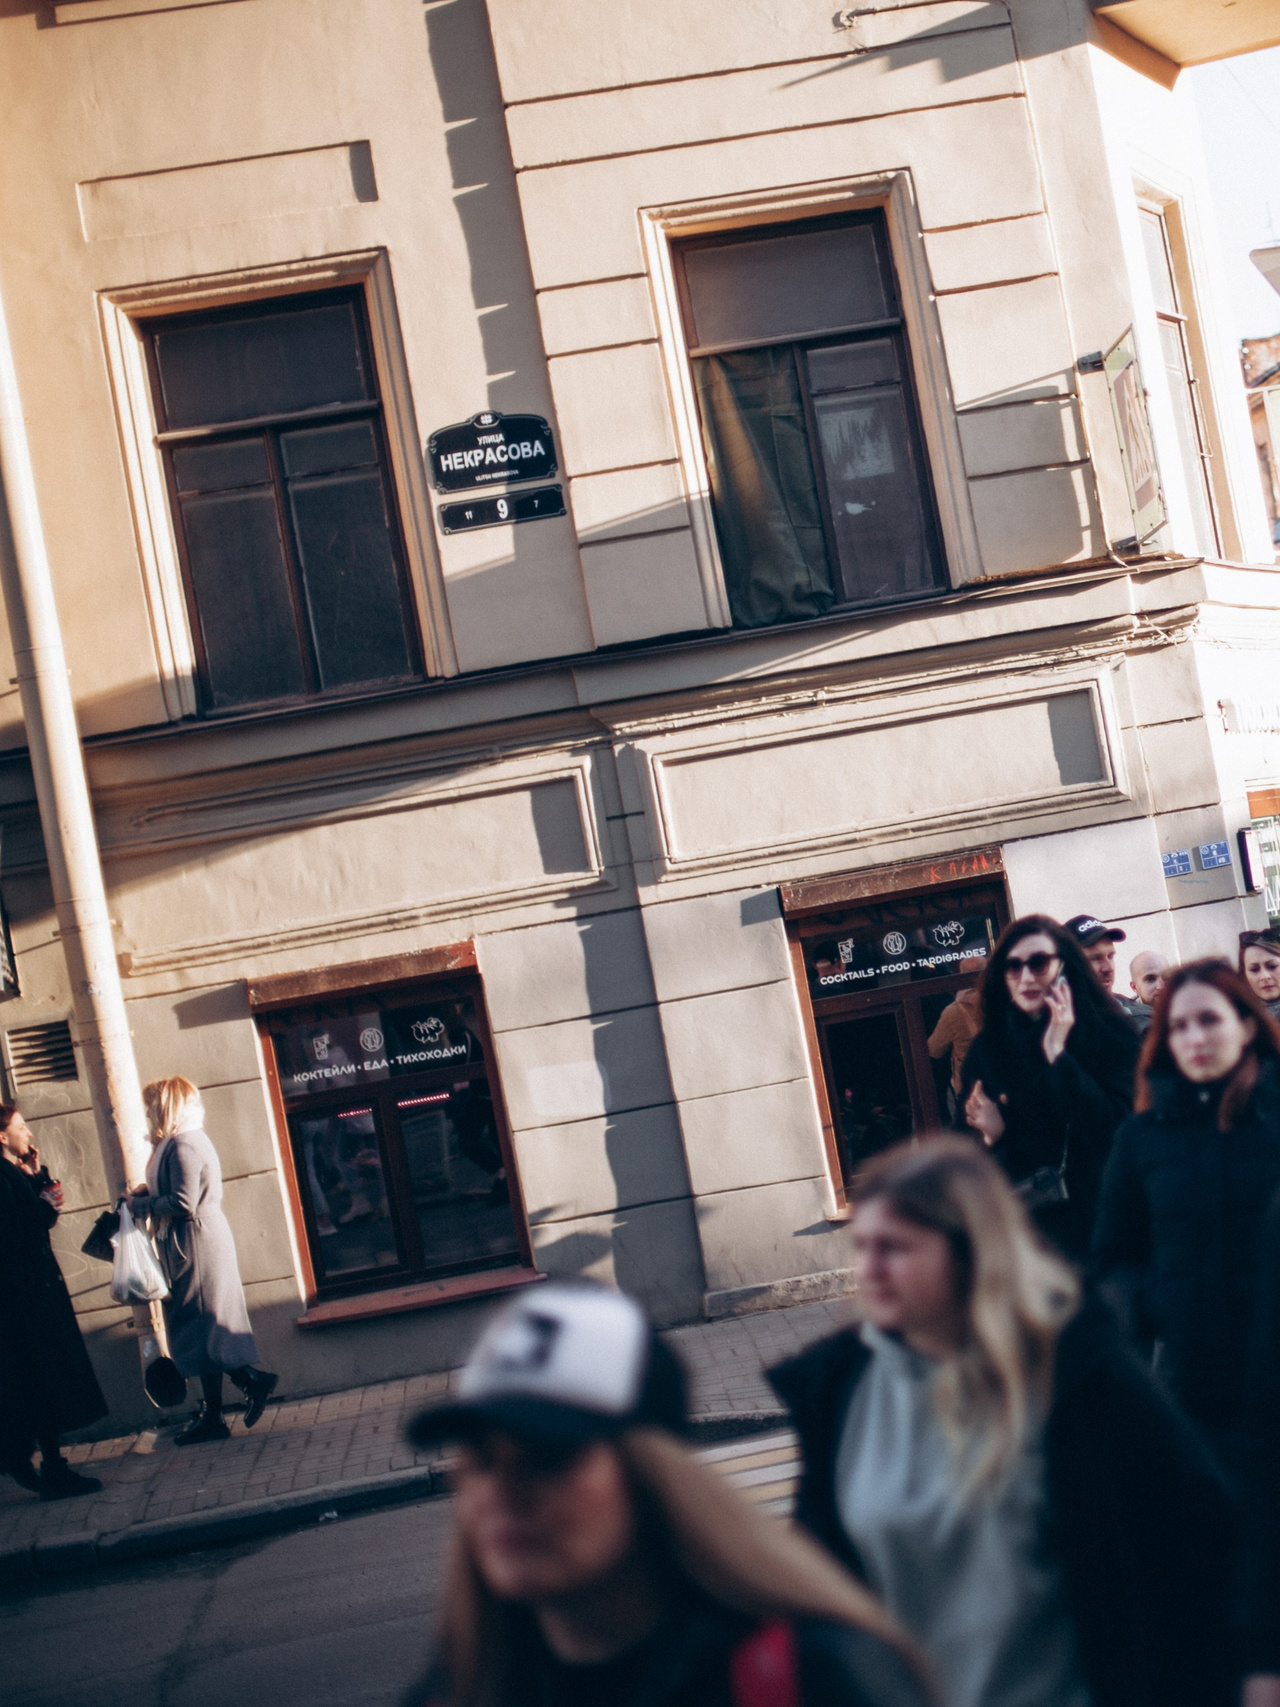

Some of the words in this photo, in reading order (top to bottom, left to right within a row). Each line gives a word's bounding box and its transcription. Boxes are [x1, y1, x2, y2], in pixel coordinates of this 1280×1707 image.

[477, 433, 504, 445] УЛИЦА
[440, 440, 546, 472] НЕКРАСОВА
[465, 510, 473, 520] 11
[497, 499, 508, 519] 9
[533, 500, 539, 509] 7
[820, 968, 876, 985] COCKTAILS
[881, 962, 910, 974] FOOD
[917, 947, 987, 967] TARDIGRADES
[293, 1064, 356, 1083] КОКТЕЙЛИ
[363, 1060, 389, 1072] ЕДА
[396, 1045, 467, 1066] ТИХОХОДКИ
